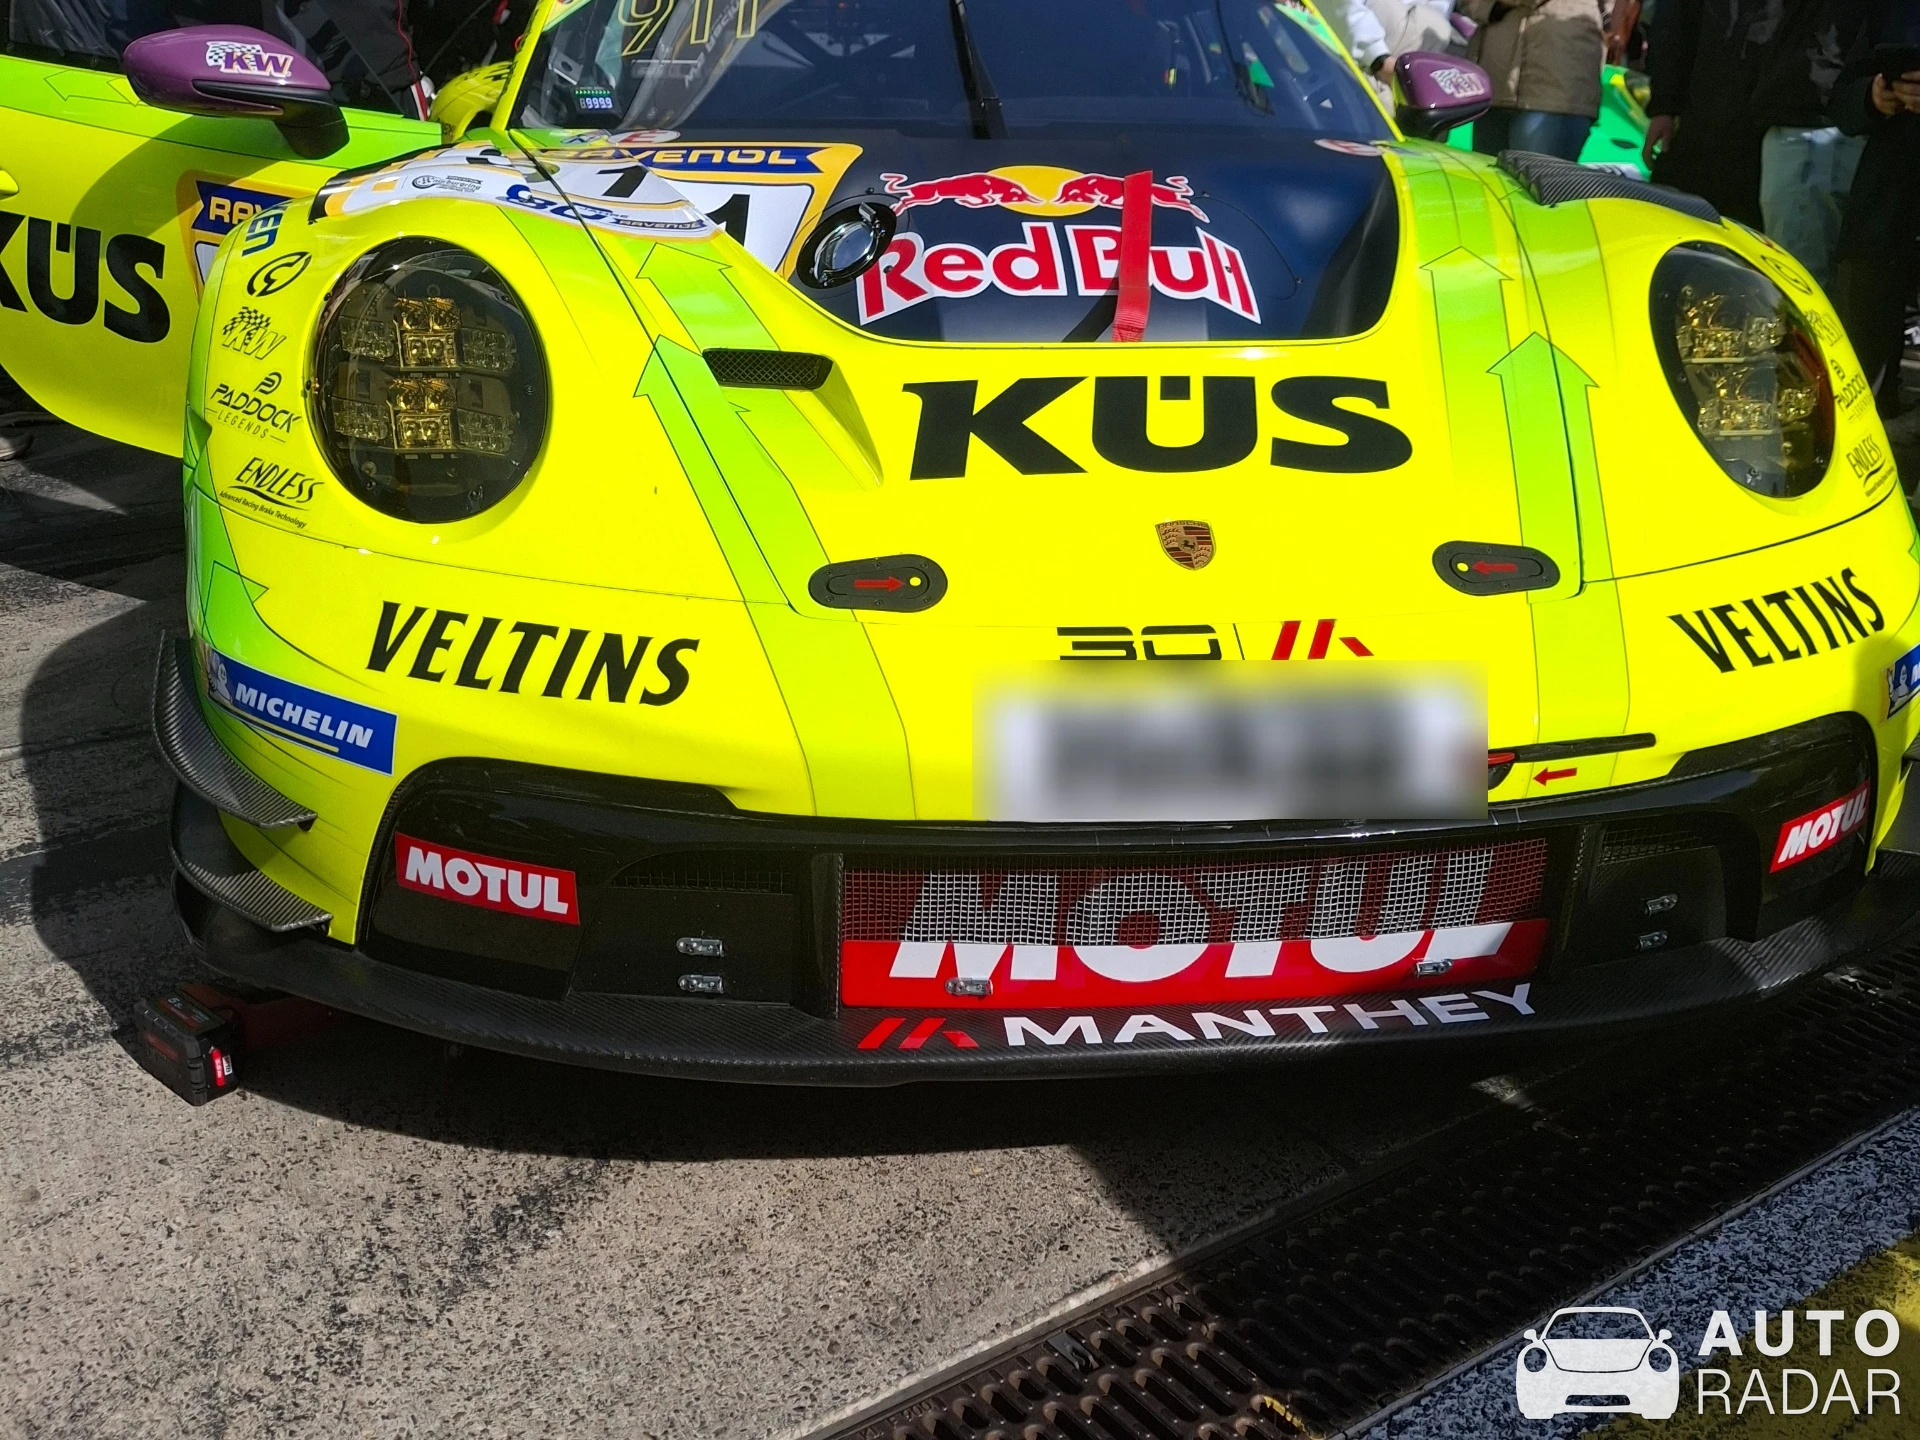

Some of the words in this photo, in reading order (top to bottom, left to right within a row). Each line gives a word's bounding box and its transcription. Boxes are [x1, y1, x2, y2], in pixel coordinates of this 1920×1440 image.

[223, 51, 293, 76] KW
[859, 223, 1064, 322] Red
[1067, 226, 1259, 323] Bull
[211, 383, 302, 433] PADDOCK
[217, 410, 269, 438] LEGENDS
[902, 376, 1413, 480] KÜS
[235, 457, 325, 504] ENDLESS
[1846, 434, 1884, 479] ENDLESS
[219, 491, 242, 505] Advanced
[242, 498, 259, 512] Racing
[258, 504, 275, 517] Brake
[274, 510, 307, 529] Technology
[1056, 625, 1223, 661] 30
[1667, 566, 1885, 674] VELTINS
[367, 600, 699, 706] VELTINS
[234, 682, 374, 749] MICHELIN
[1778, 788, 1868, 864] MOTUL
[404, 846, 569, 915] MOTUL
[889, 846, 1514, 983] MOTUL
[1007, 983, 1537, 1047] MANTHEY
